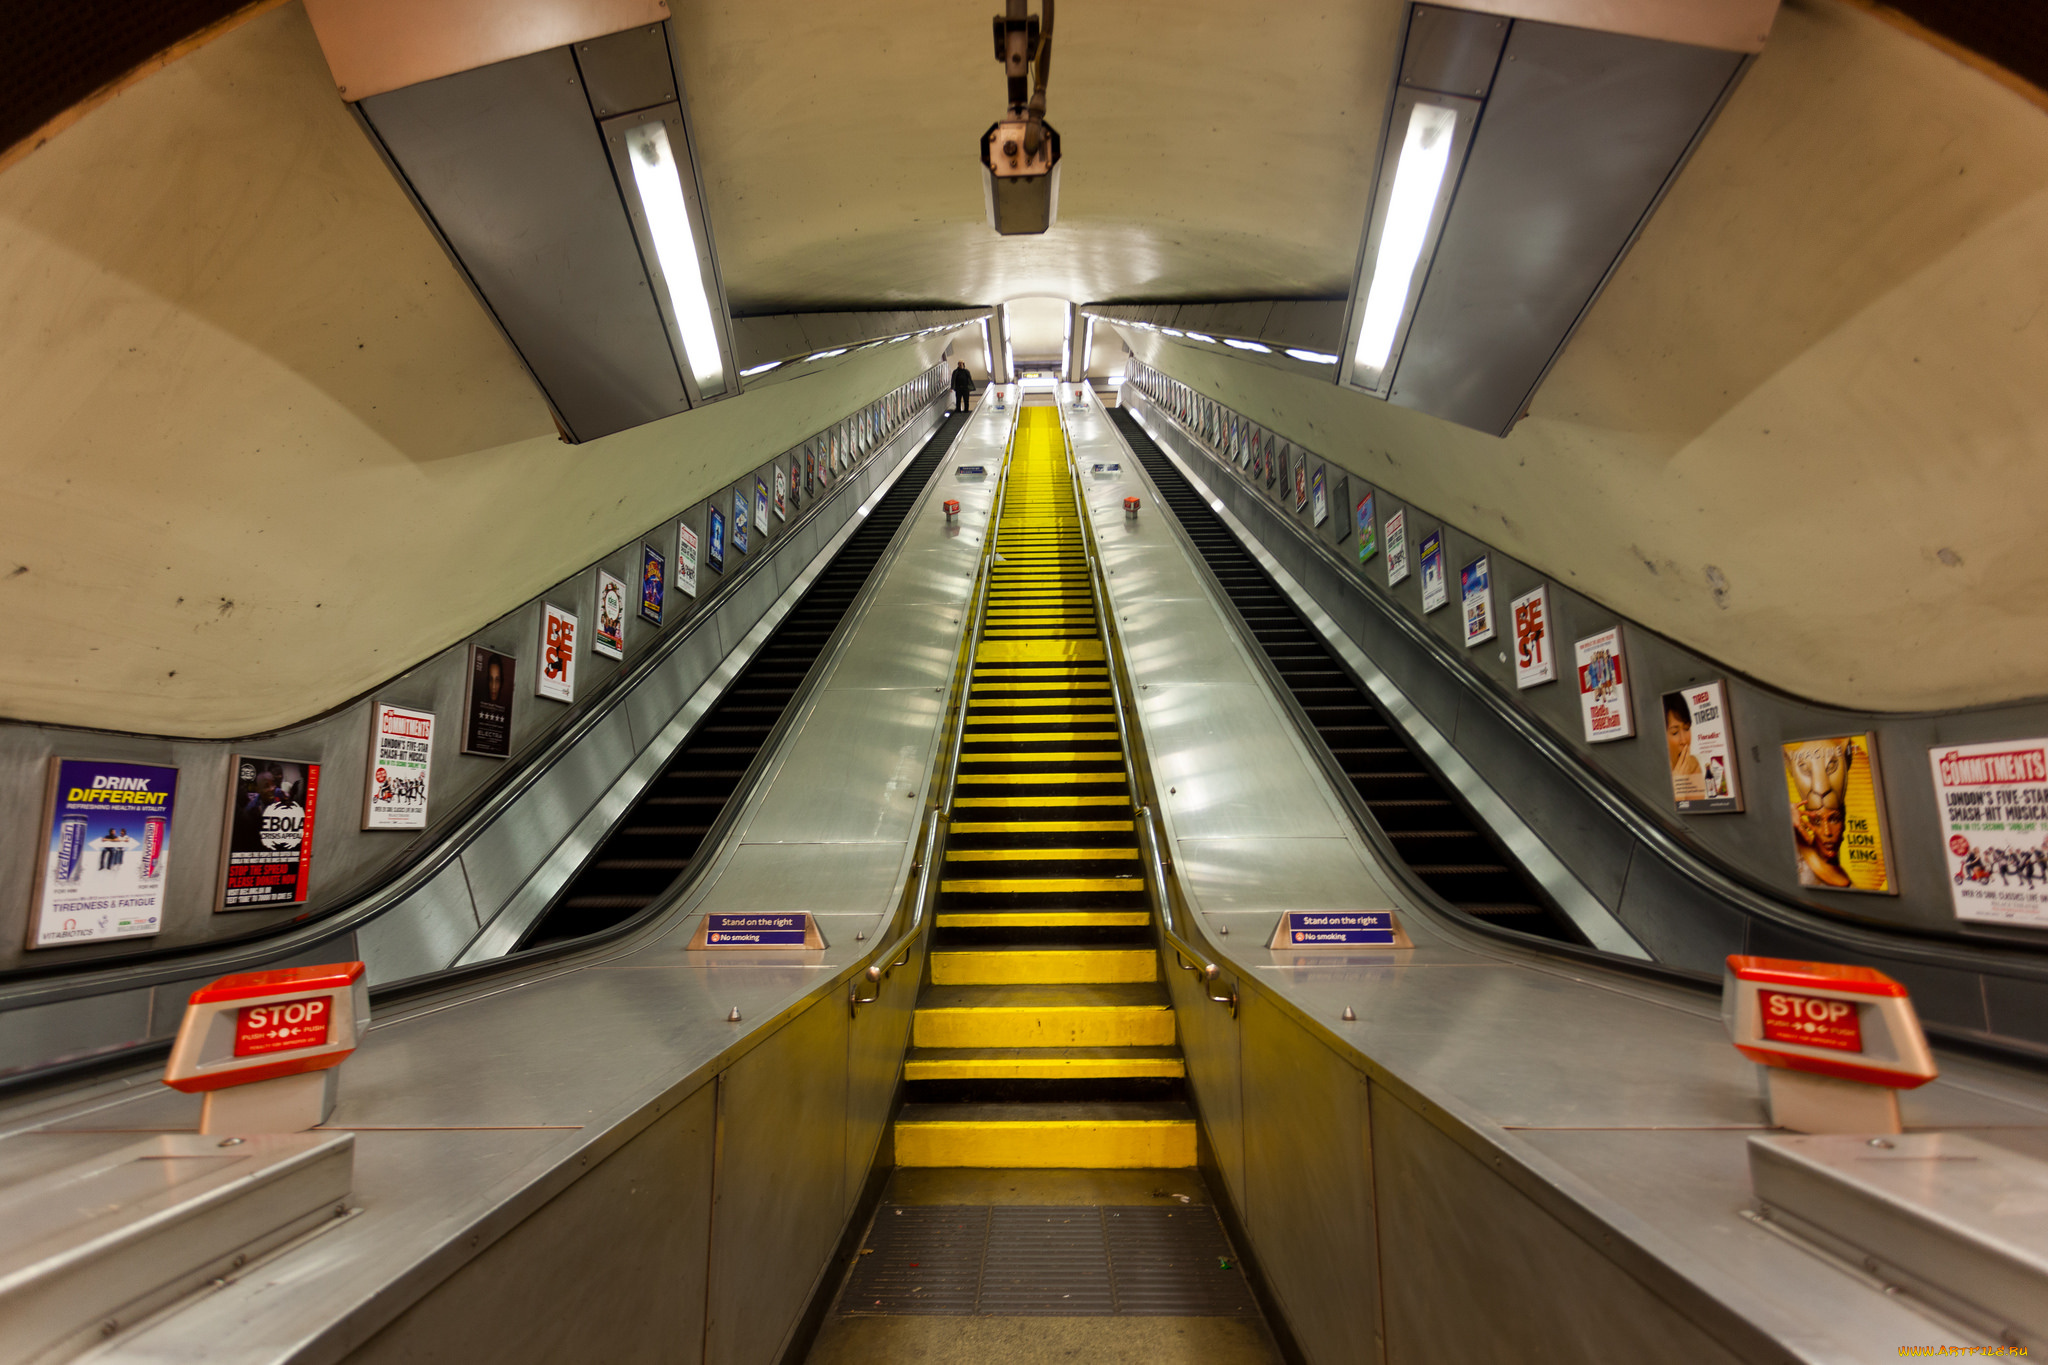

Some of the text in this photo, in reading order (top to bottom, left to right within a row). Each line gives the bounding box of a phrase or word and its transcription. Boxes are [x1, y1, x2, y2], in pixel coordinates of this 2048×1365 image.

[1692, 691, 1710, 705] TIRED
[382, 714, 430, 738] COMMITMENTS
[380, 737, 428, 752] LONDON'S FIVE-STAR
[380, 748, 427, 763] SMASH-HIT MUSICAL
[1941, 751, 2046, 785] COMMITMENTS
[92, 775, 151, 790] DRINK
[67, 788, 168, 804] DIFFERENT
[1945, 790, 1993, 806] LONDON'S
[66, 803, 110, 811] REFRESHING
[1949, 805, 2048, 821] SMASH-HIT MUSICA
[262, 816, 305, 832] EBOLA
[1847, 819, 1869, 830] THE
[1847, 834, 1874, 845] LION
[58, 824, 74, 880] wellman
[142, 823, 155, 877] wellwoman
[1849, 849, 1877, 860] KING
[229, 864, 288, 876] STOP THE SPREAD
[228, 874, 297, 887] PLEASE DONATE NOW
[53, 898, 156, 912] TIREDNESS & FATIGUE
[721, 918, 745, 926] Stand
[758, 918, 772, 926] the
[773, 918, 793, 927] right
[1303, 916, 1328, 925] Stand
[1341, 916, 1356, 925] the
[1357, 916, 1378, 926] right
[43, 929, 94, 940] VITABIOTICS
[731, 934, 760, 942] smoking
[1317, 933, 1347, 941] smoking
[248, 1001, 324, 1028] STOP
[1769, 994, 1849, 1022] STOP
[241, 1033, 265, 1041] PUSH
